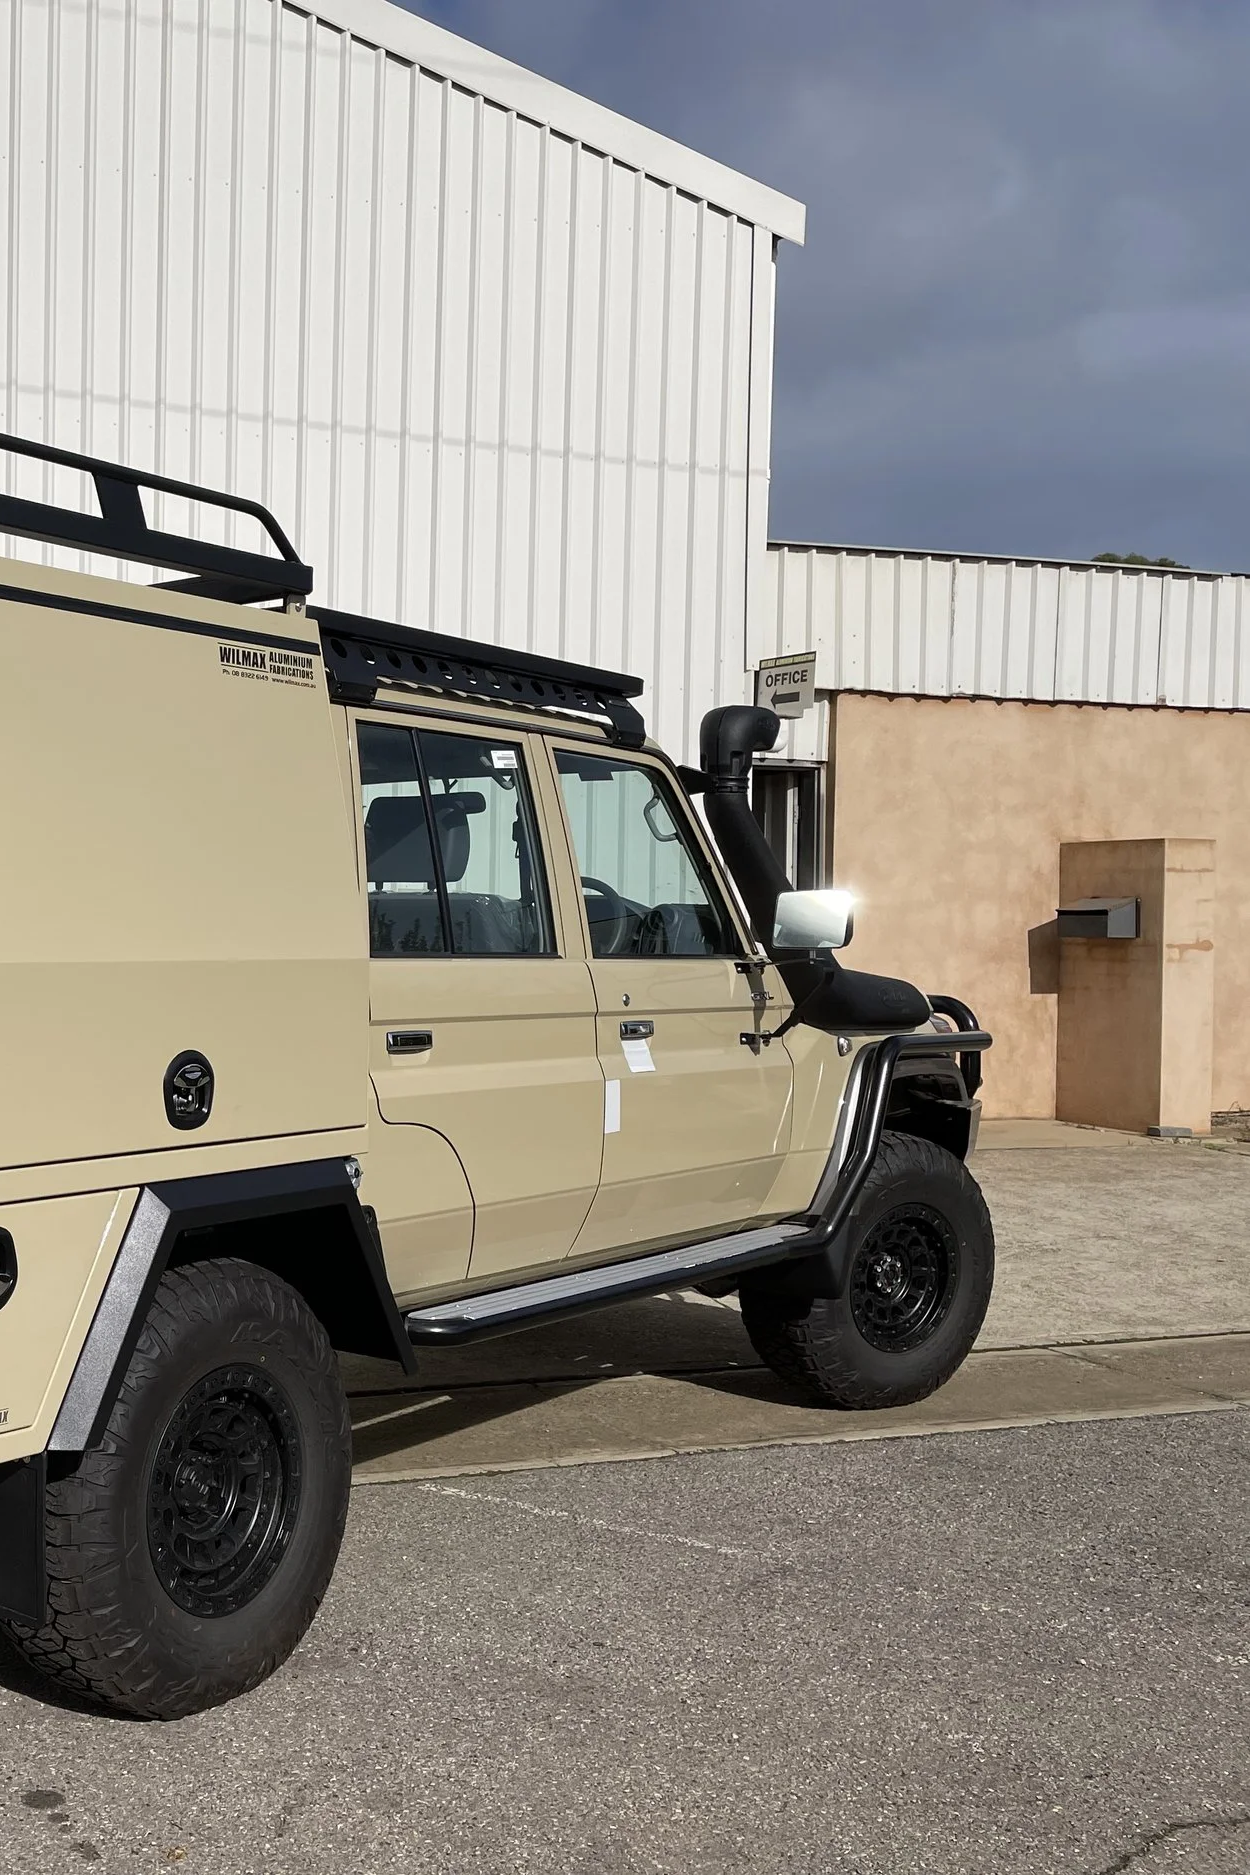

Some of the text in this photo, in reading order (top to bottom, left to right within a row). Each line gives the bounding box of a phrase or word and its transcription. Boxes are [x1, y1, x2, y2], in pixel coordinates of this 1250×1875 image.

[219, 646, 313, 669] WILMAX ALUMINIUM
[240, 671, 255, 679] 8322
[272, 677, 317, 689] www.wilmax.com.au
[269, 664, 314, 681] FABRICATIONS
[765, 669, 808, 688] OFFICE
